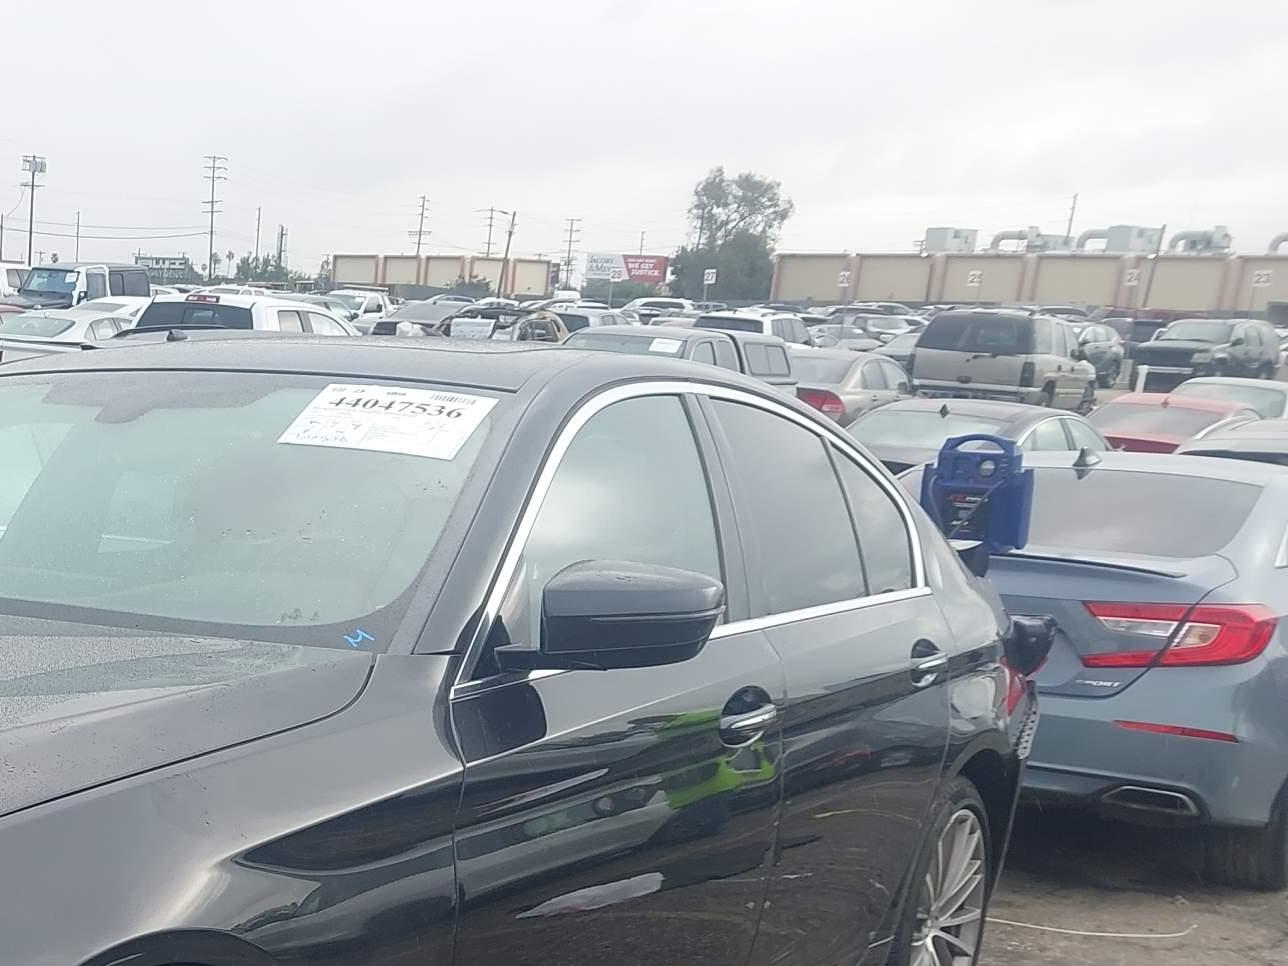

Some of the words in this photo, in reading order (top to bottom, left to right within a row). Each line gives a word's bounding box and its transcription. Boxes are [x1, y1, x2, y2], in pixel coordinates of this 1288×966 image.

[610, 270, 623, 280] 28
[704, 271, 716, 282] 27
[1254, 272, 1273, 285] 23
[327, 396, 466, 420] 44047536
